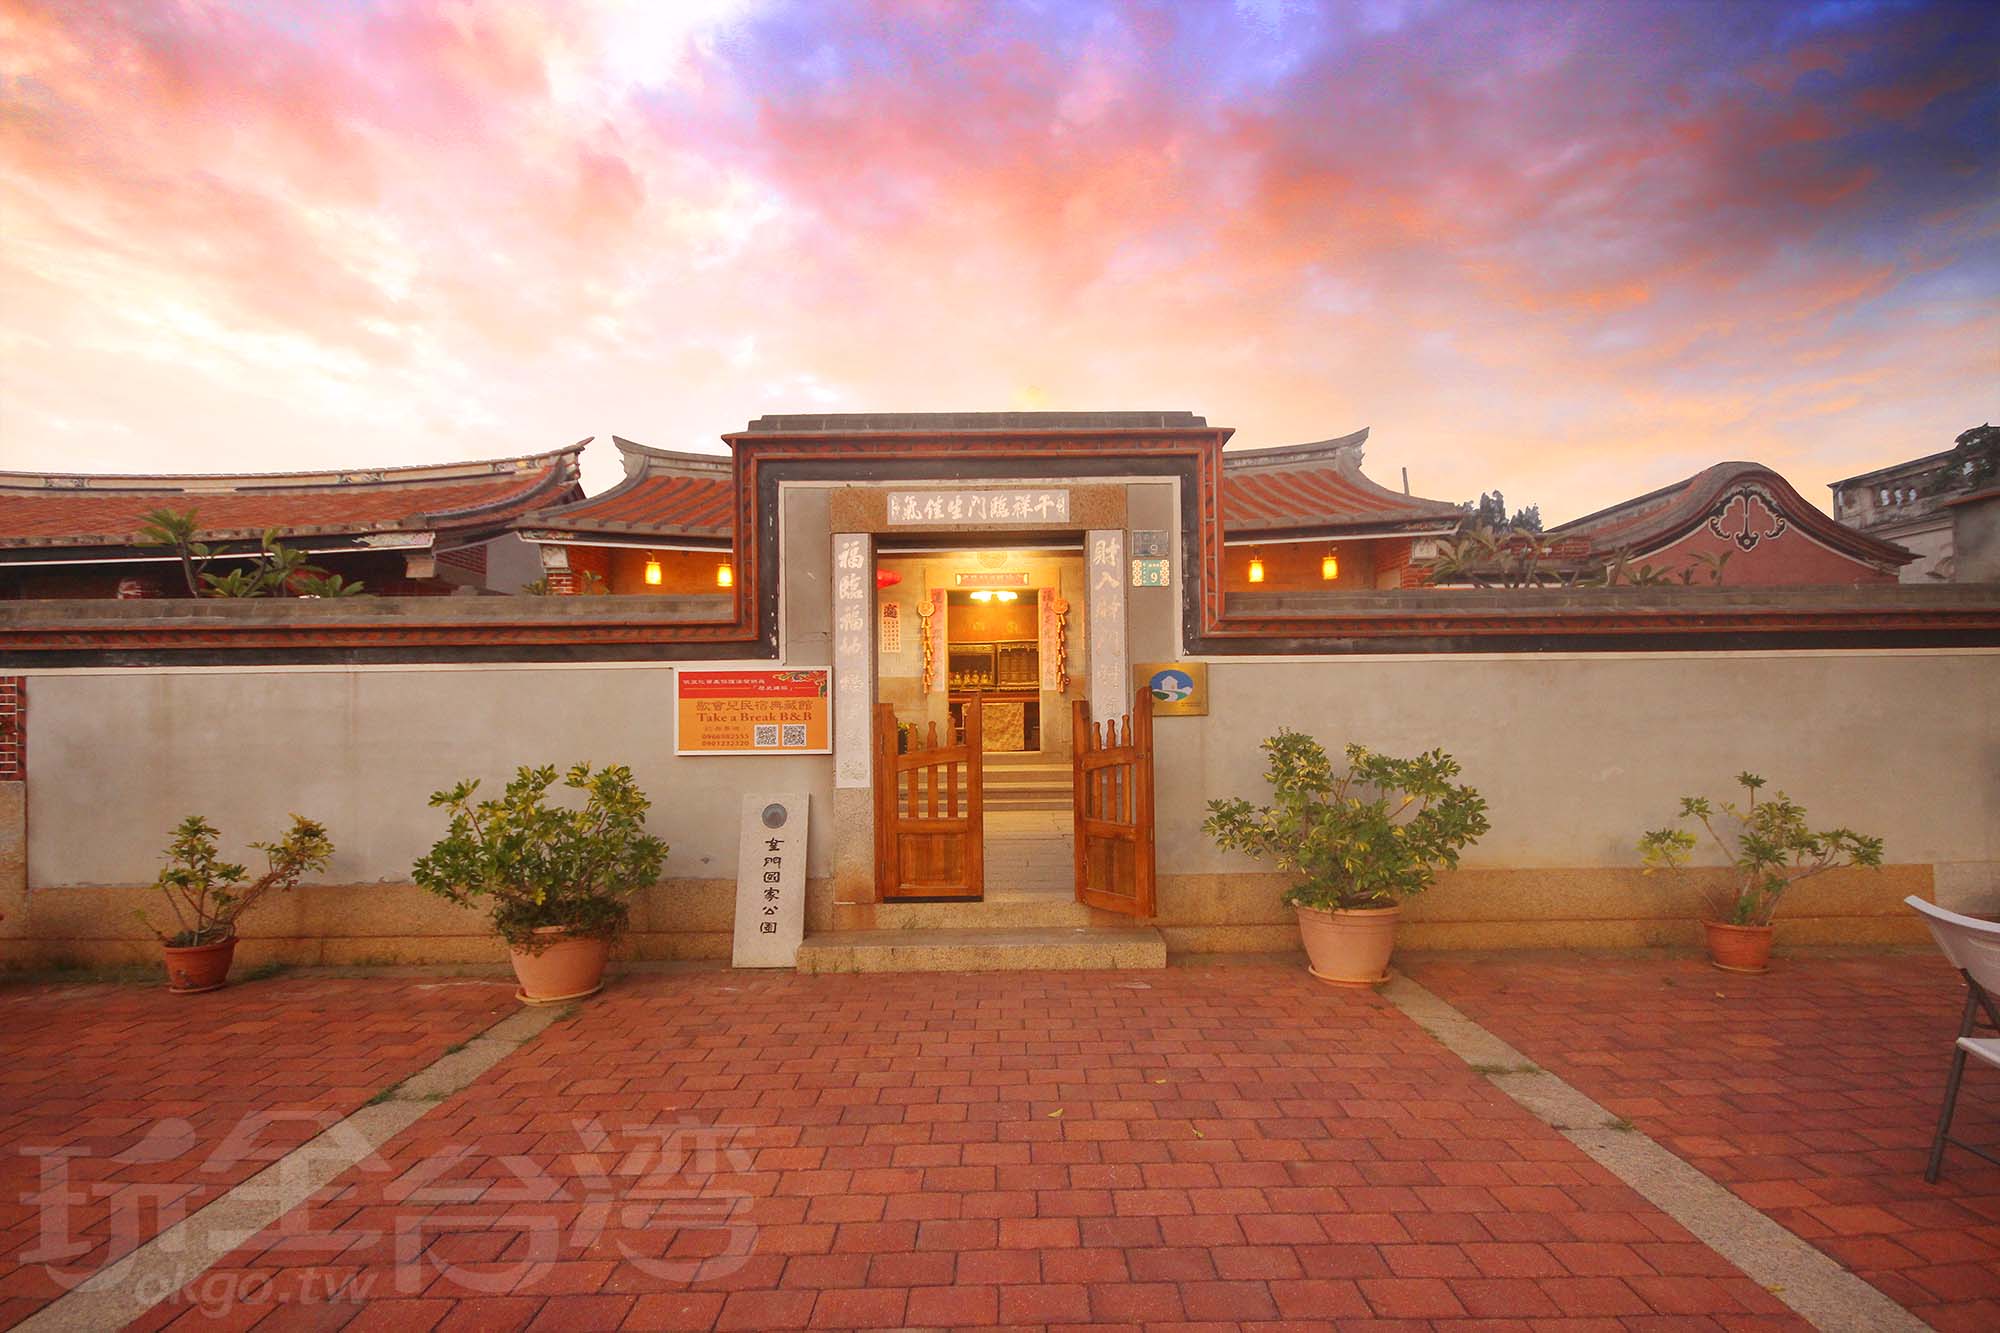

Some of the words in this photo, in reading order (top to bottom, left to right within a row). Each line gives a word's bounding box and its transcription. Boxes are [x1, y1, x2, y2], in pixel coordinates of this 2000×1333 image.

[1150, 572, 1158, 583] 9
[697, 712, 727, 723] Take
[740, 711, 778, 722] Break
